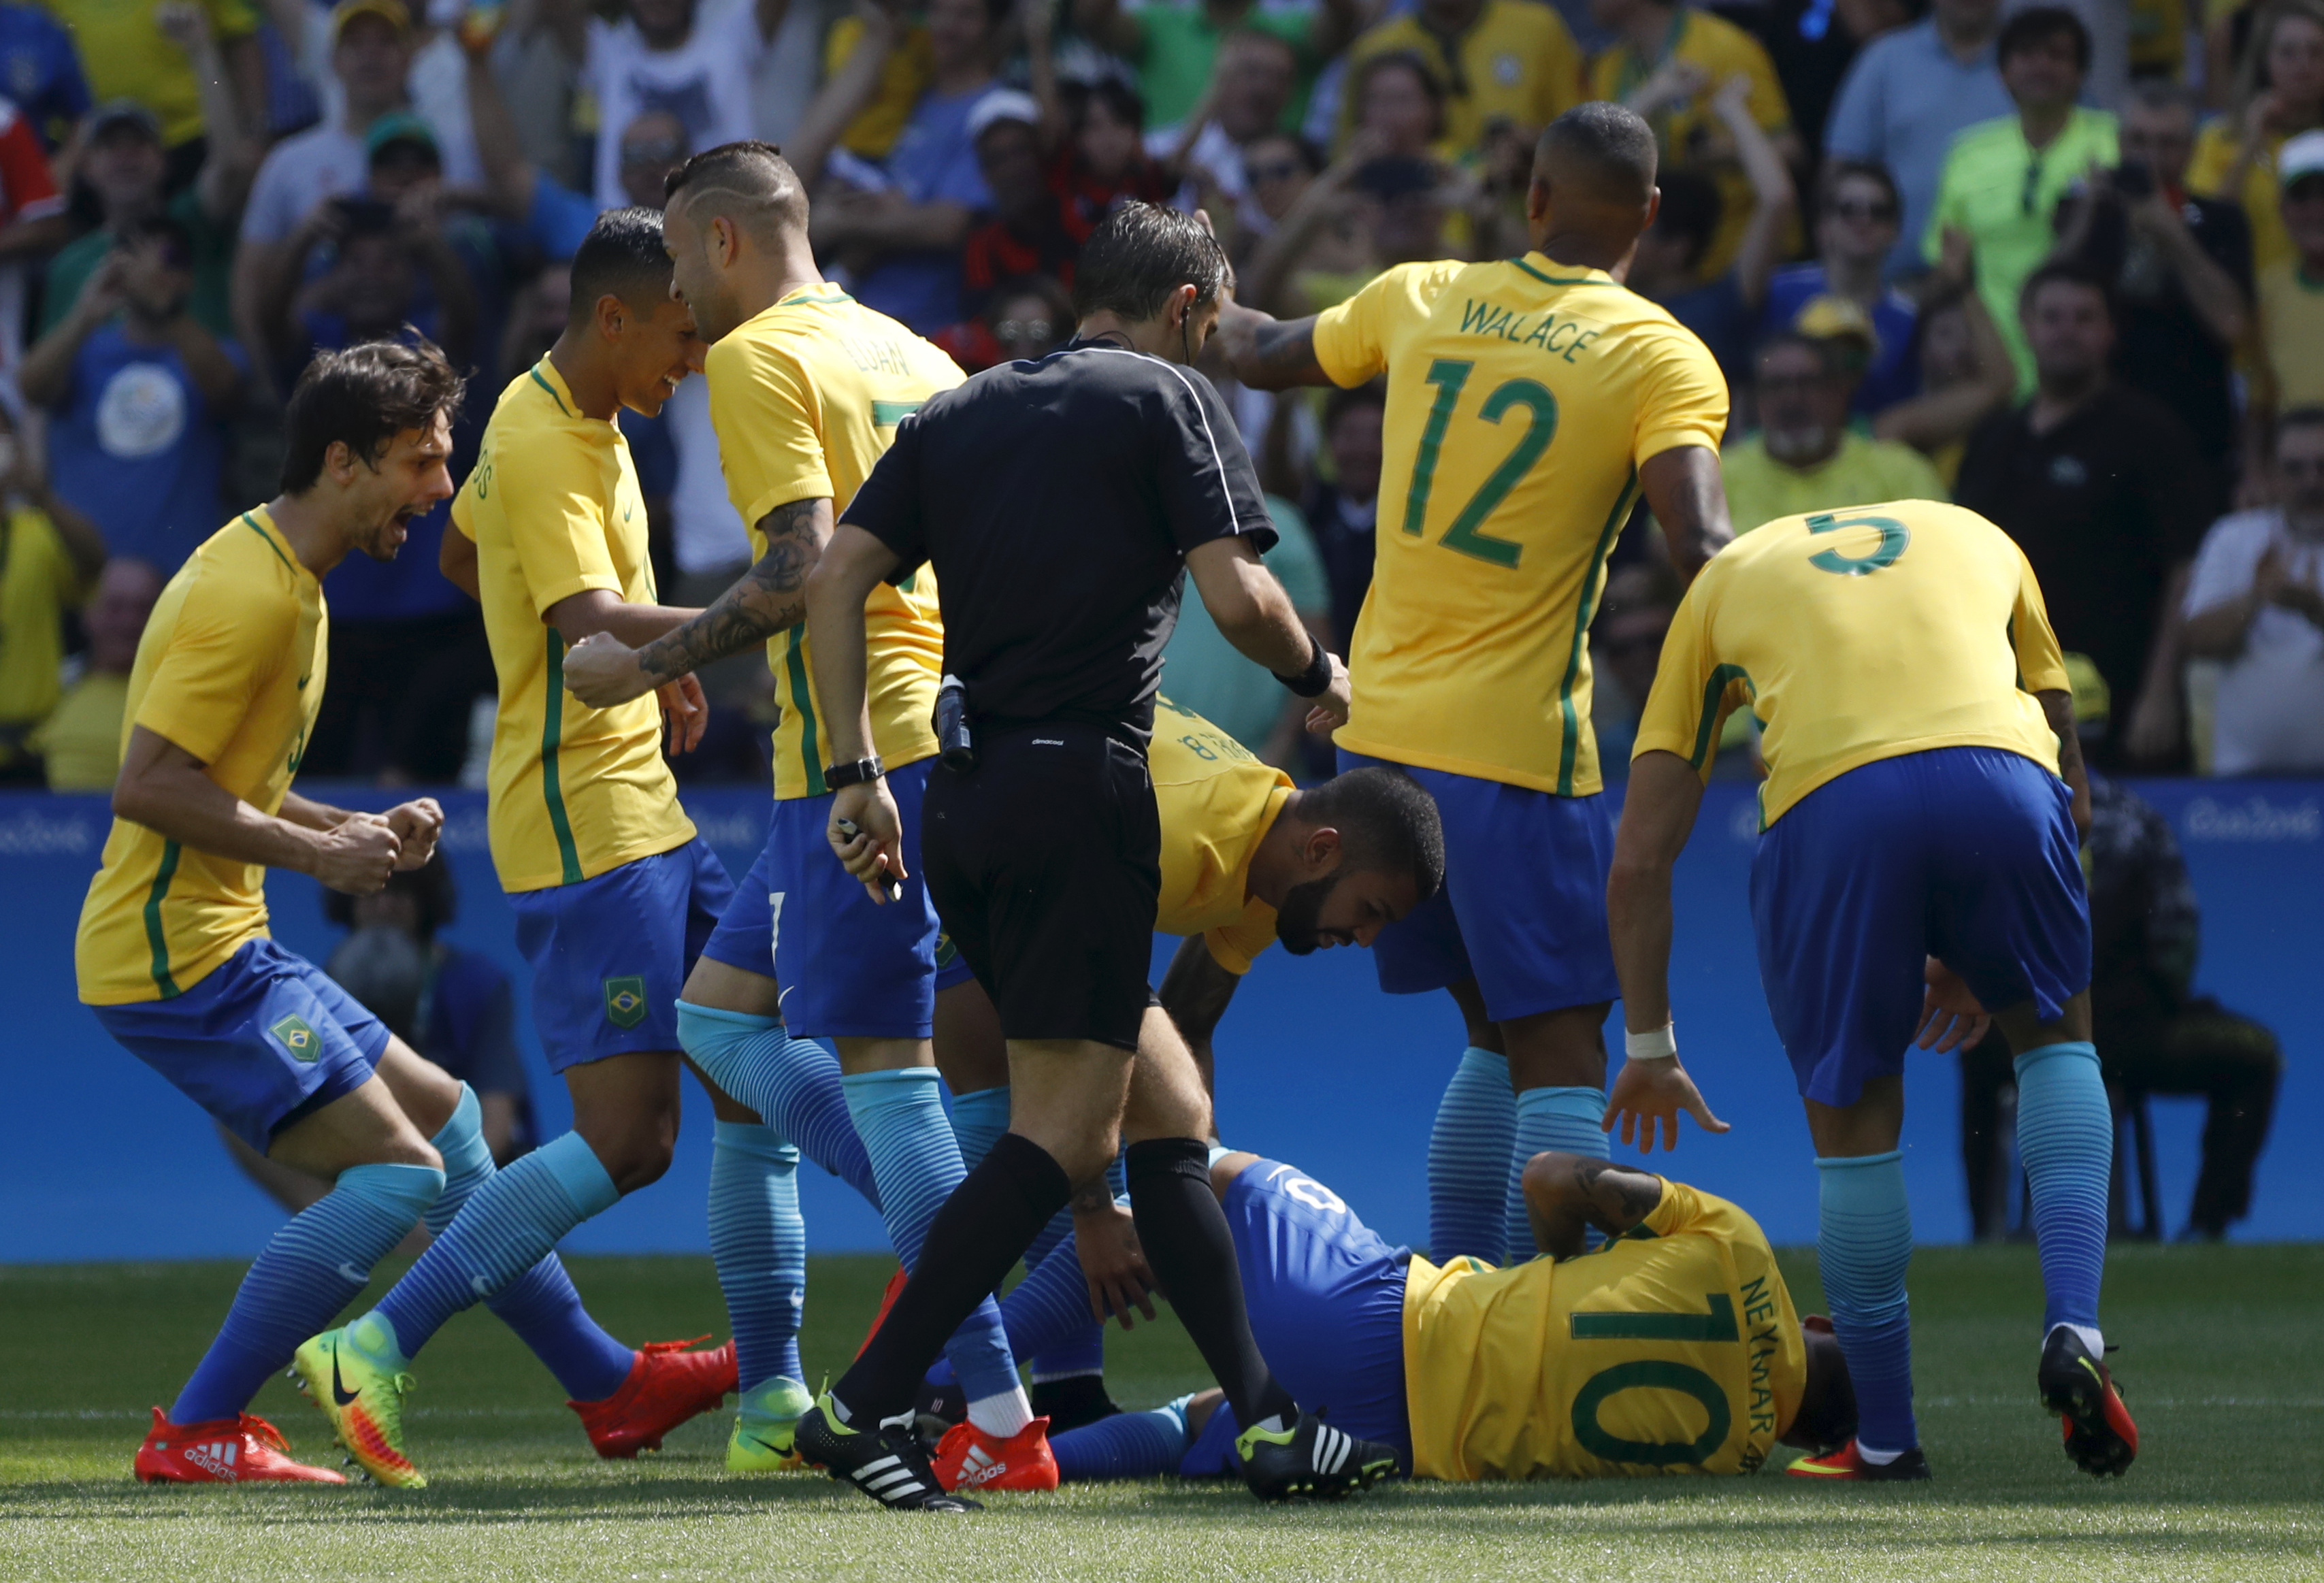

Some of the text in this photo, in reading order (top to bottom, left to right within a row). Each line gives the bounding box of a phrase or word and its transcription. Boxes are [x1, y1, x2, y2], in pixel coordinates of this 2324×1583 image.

[1459, 298, 1600, 364] WALACE
[1402, 358, 1559, 570] 12
[1804, 506, 1911, 576] 5
[1570, 1292, 1740, 1466] 10
[1740, 1275, 1779, 1435] NEYMAR
[184, 1448, 238, 1482] adidas
[956, 1461, 1006, 1489] adidas
